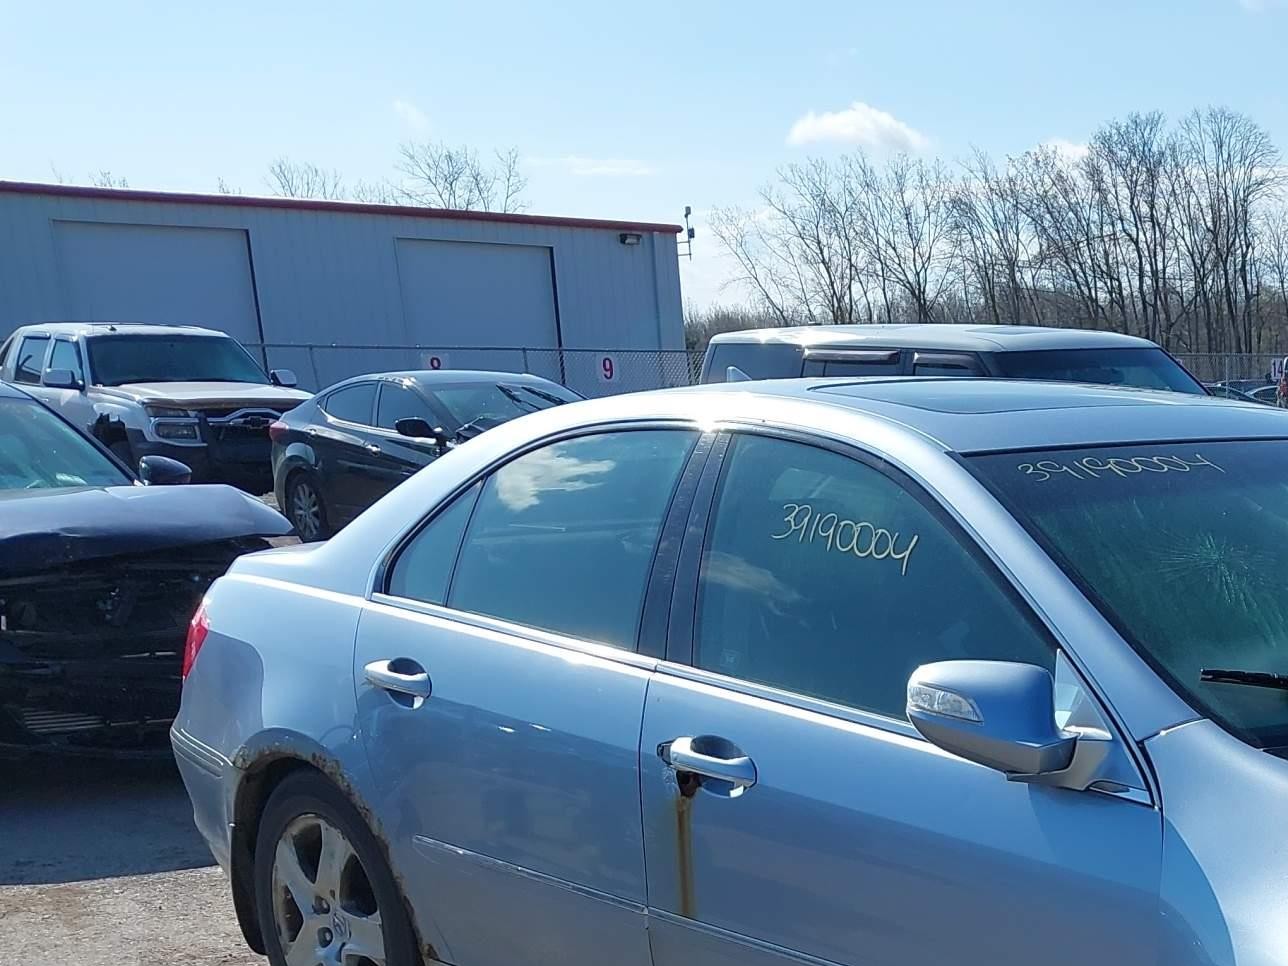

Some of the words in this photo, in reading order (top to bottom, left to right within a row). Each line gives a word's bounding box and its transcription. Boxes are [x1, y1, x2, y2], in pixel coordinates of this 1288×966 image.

[602, 357, 614, 380] 9
[1272, 359, 1284, 377] 14
[1017, 453, 1226, 482] 39190004
[771, 503, 919, 576] 39190004
